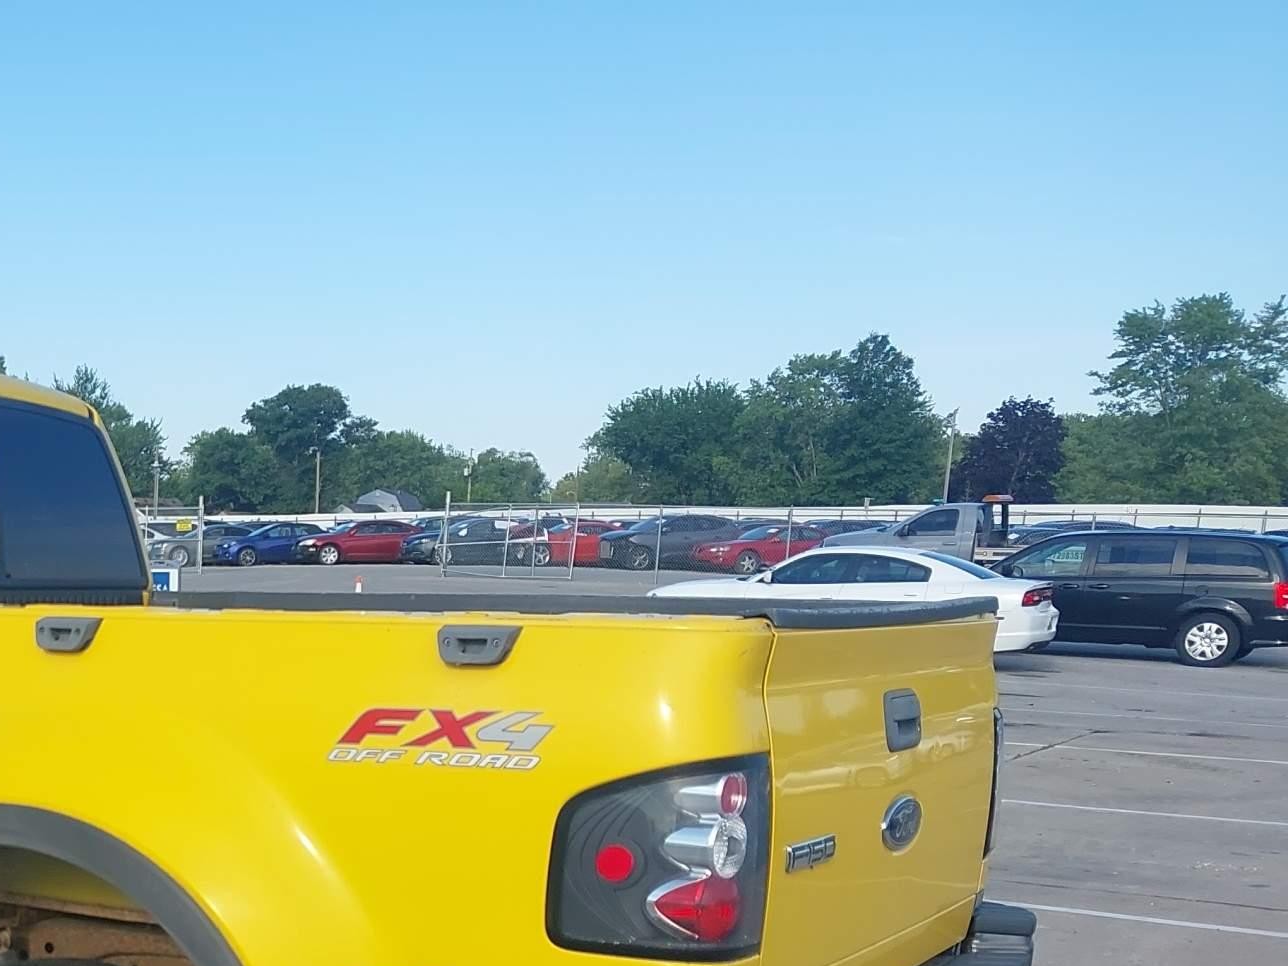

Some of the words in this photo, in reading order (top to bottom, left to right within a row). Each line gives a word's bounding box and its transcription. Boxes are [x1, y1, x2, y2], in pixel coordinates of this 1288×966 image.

[336, 708, 556, 751] FX4
[327, 748, 408, 763] OFF
[414, 750, 542, 770] ROAD
